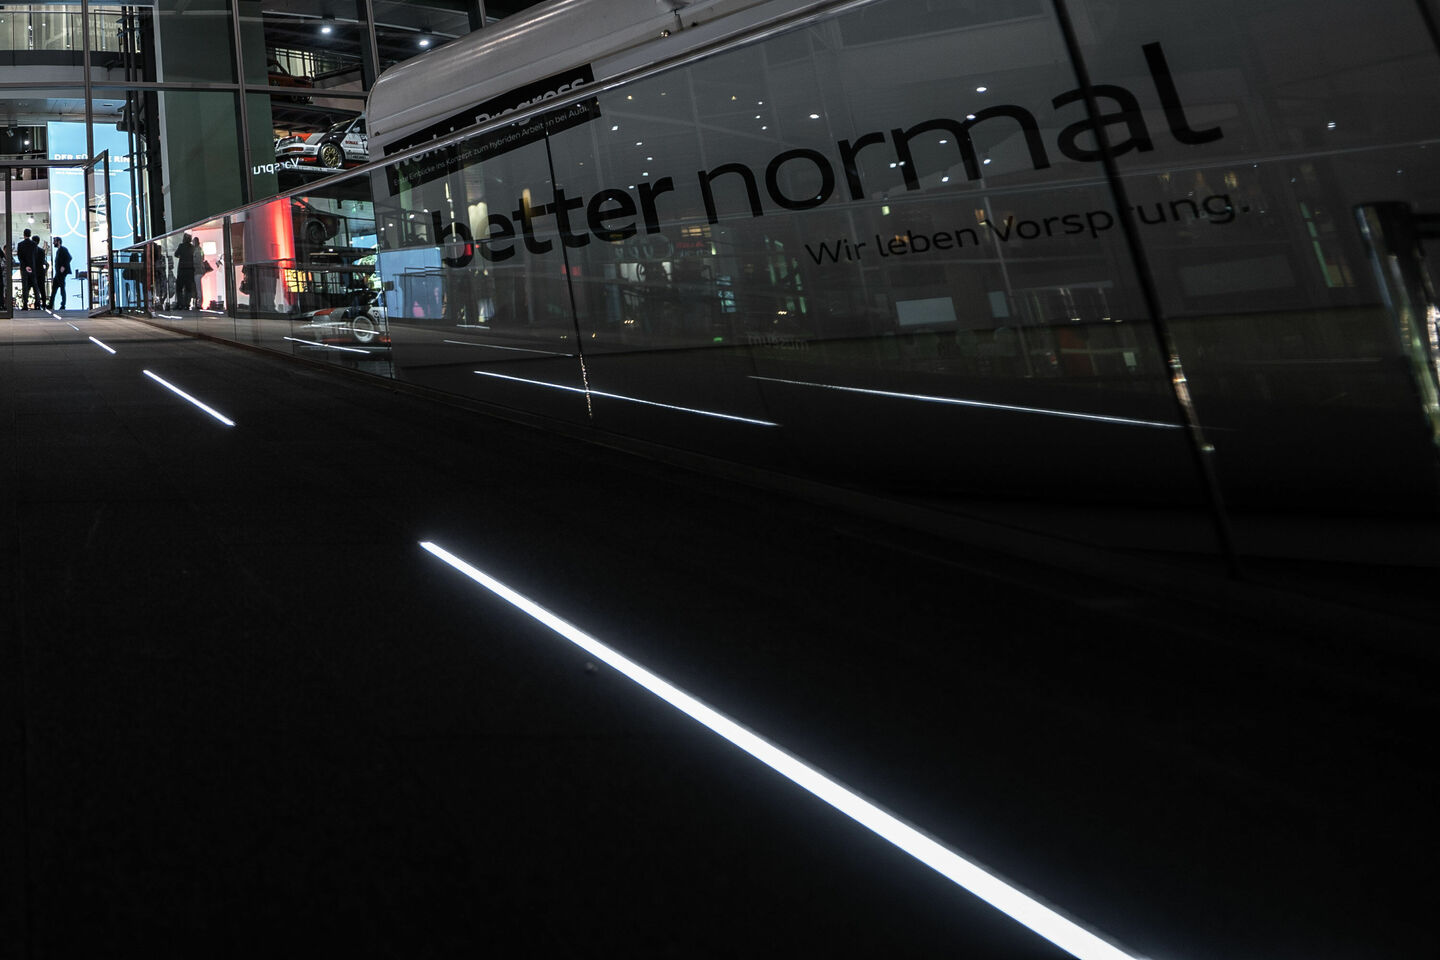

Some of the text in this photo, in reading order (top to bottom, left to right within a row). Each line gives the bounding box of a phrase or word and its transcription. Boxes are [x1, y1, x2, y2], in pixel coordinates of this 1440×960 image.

[431, 42, 1223, 269] better normal
[474, 145, 489, 155] zum
[489, 133, 520, 150] hybriden
[804, 238, 867, 267] Wir
[878, 223, 979, 258] leben
